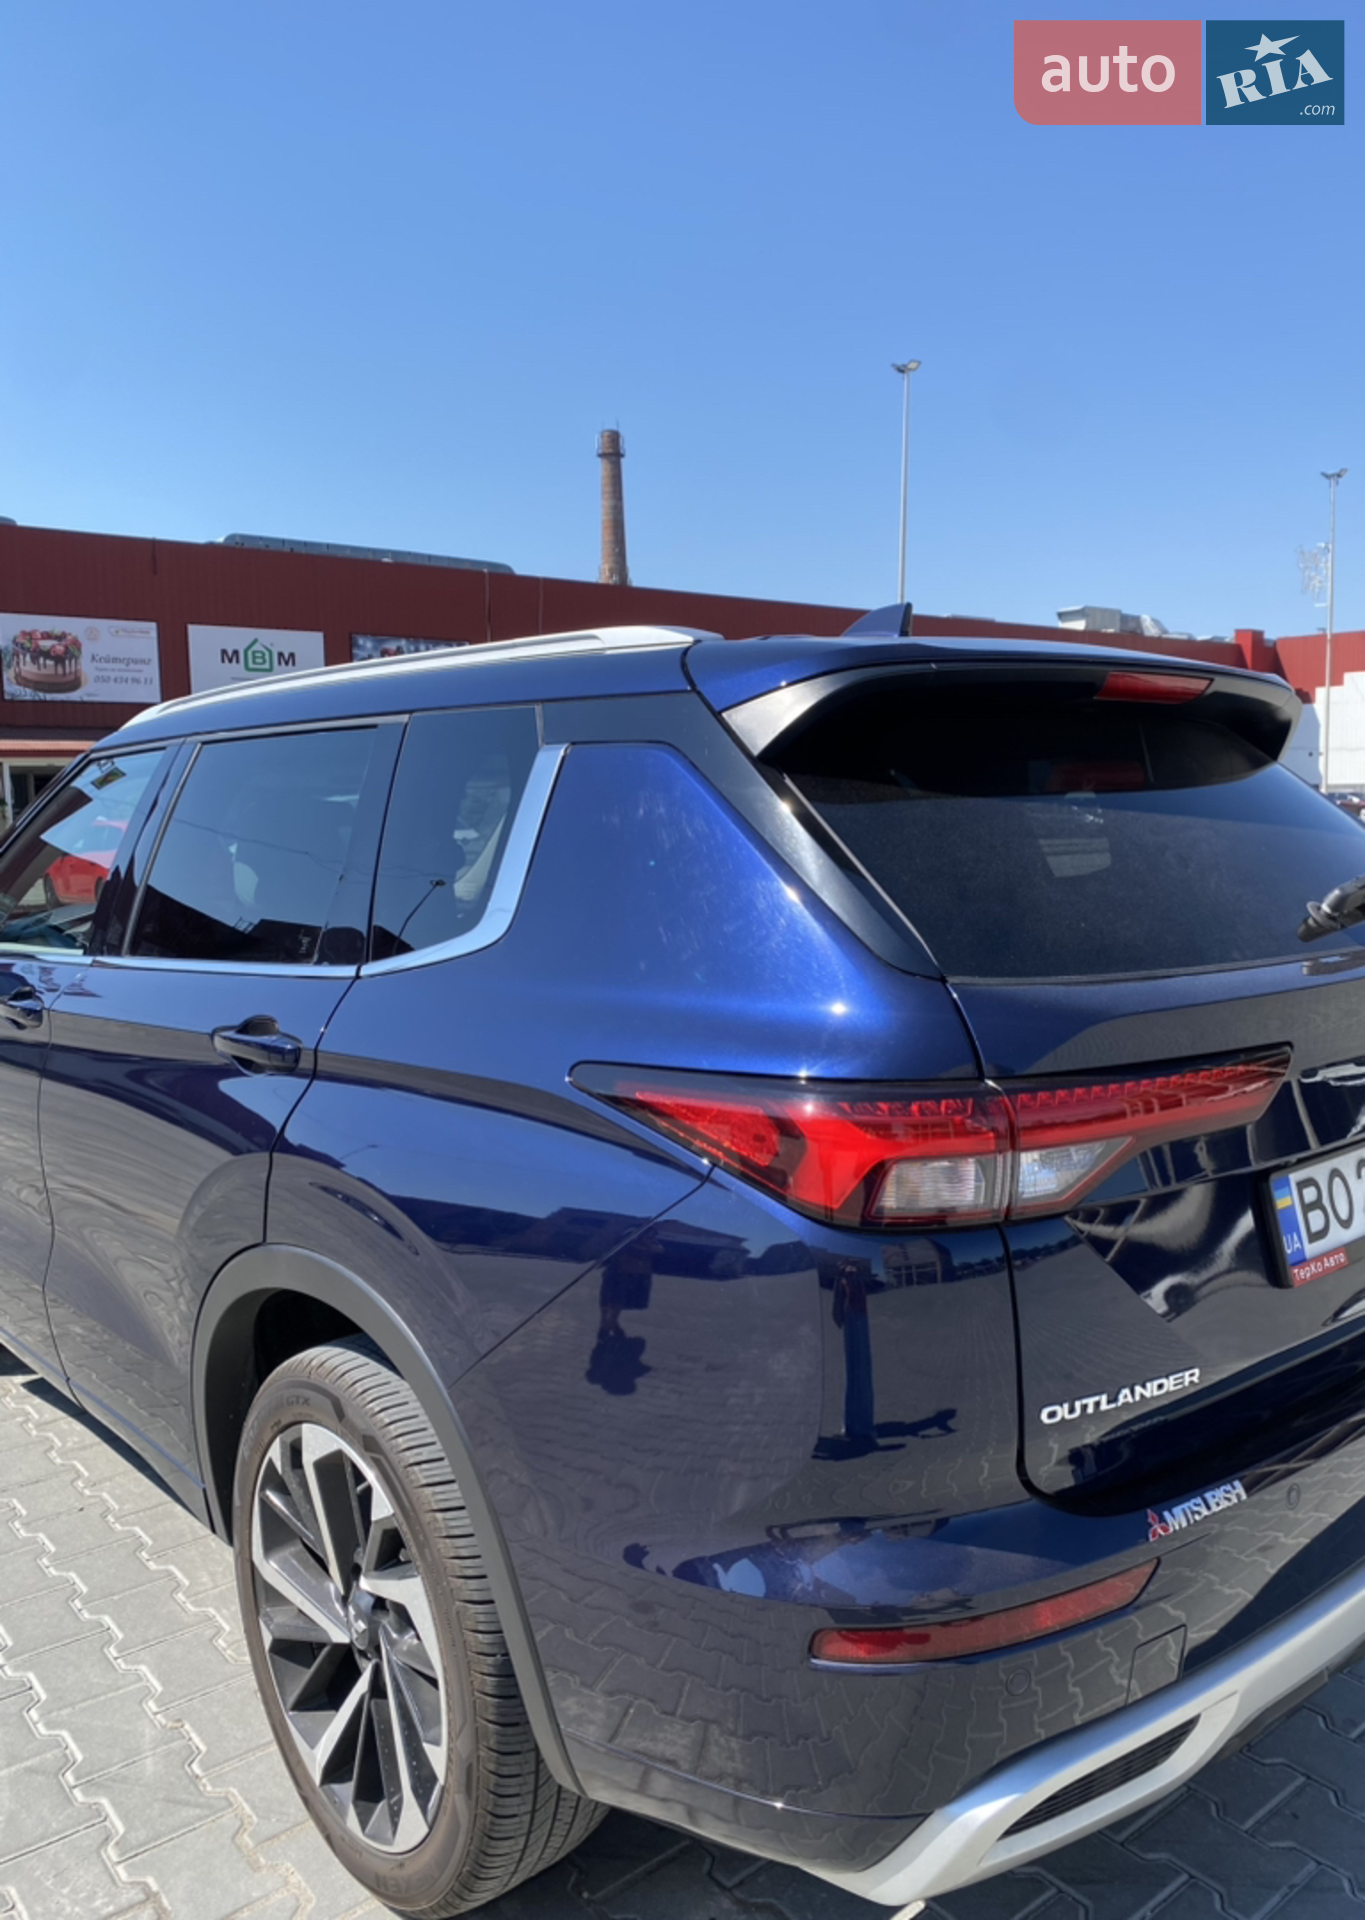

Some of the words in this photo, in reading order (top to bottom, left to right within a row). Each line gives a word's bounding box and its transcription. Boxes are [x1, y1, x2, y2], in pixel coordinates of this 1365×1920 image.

[90, 653, 152, 667] Кейтеринг
[94, 674, 111, 684] 050
[1283, 1232, 1302, 1254] UA
[285, 1395, 310, 1407] GTX
[1040, 1367, 1200, 1425] OUTLANDER
